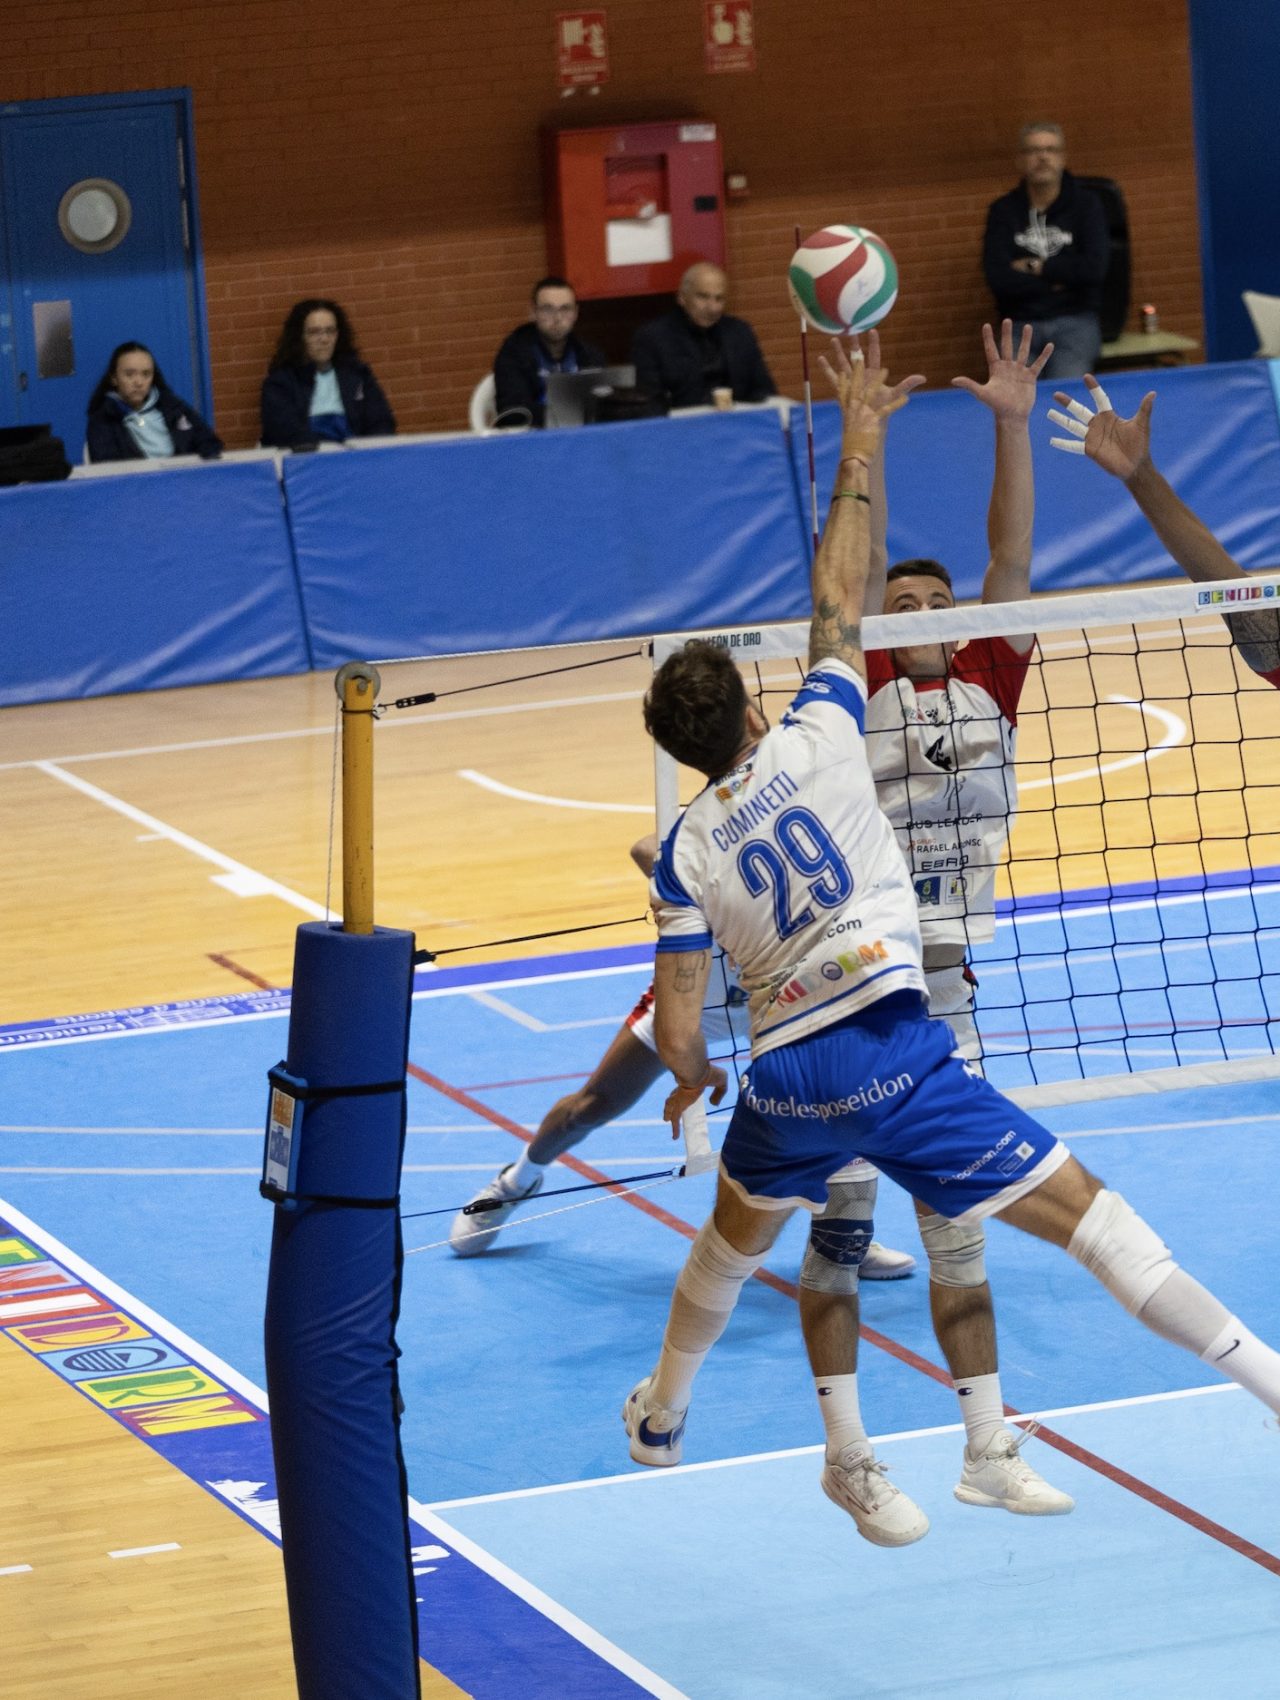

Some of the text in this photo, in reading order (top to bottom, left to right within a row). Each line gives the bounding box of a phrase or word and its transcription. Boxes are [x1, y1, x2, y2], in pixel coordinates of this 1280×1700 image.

[730, 634, 742, 648] DE
[743, 631, 762, 646] ORO
[711, 769, 799, 852] CUMINETTI
[736, 805, 855, 942] 29
[916, 845, 950, 853] RAFAEL
[745, 1072, 914, 1123] hotelesposeidon
